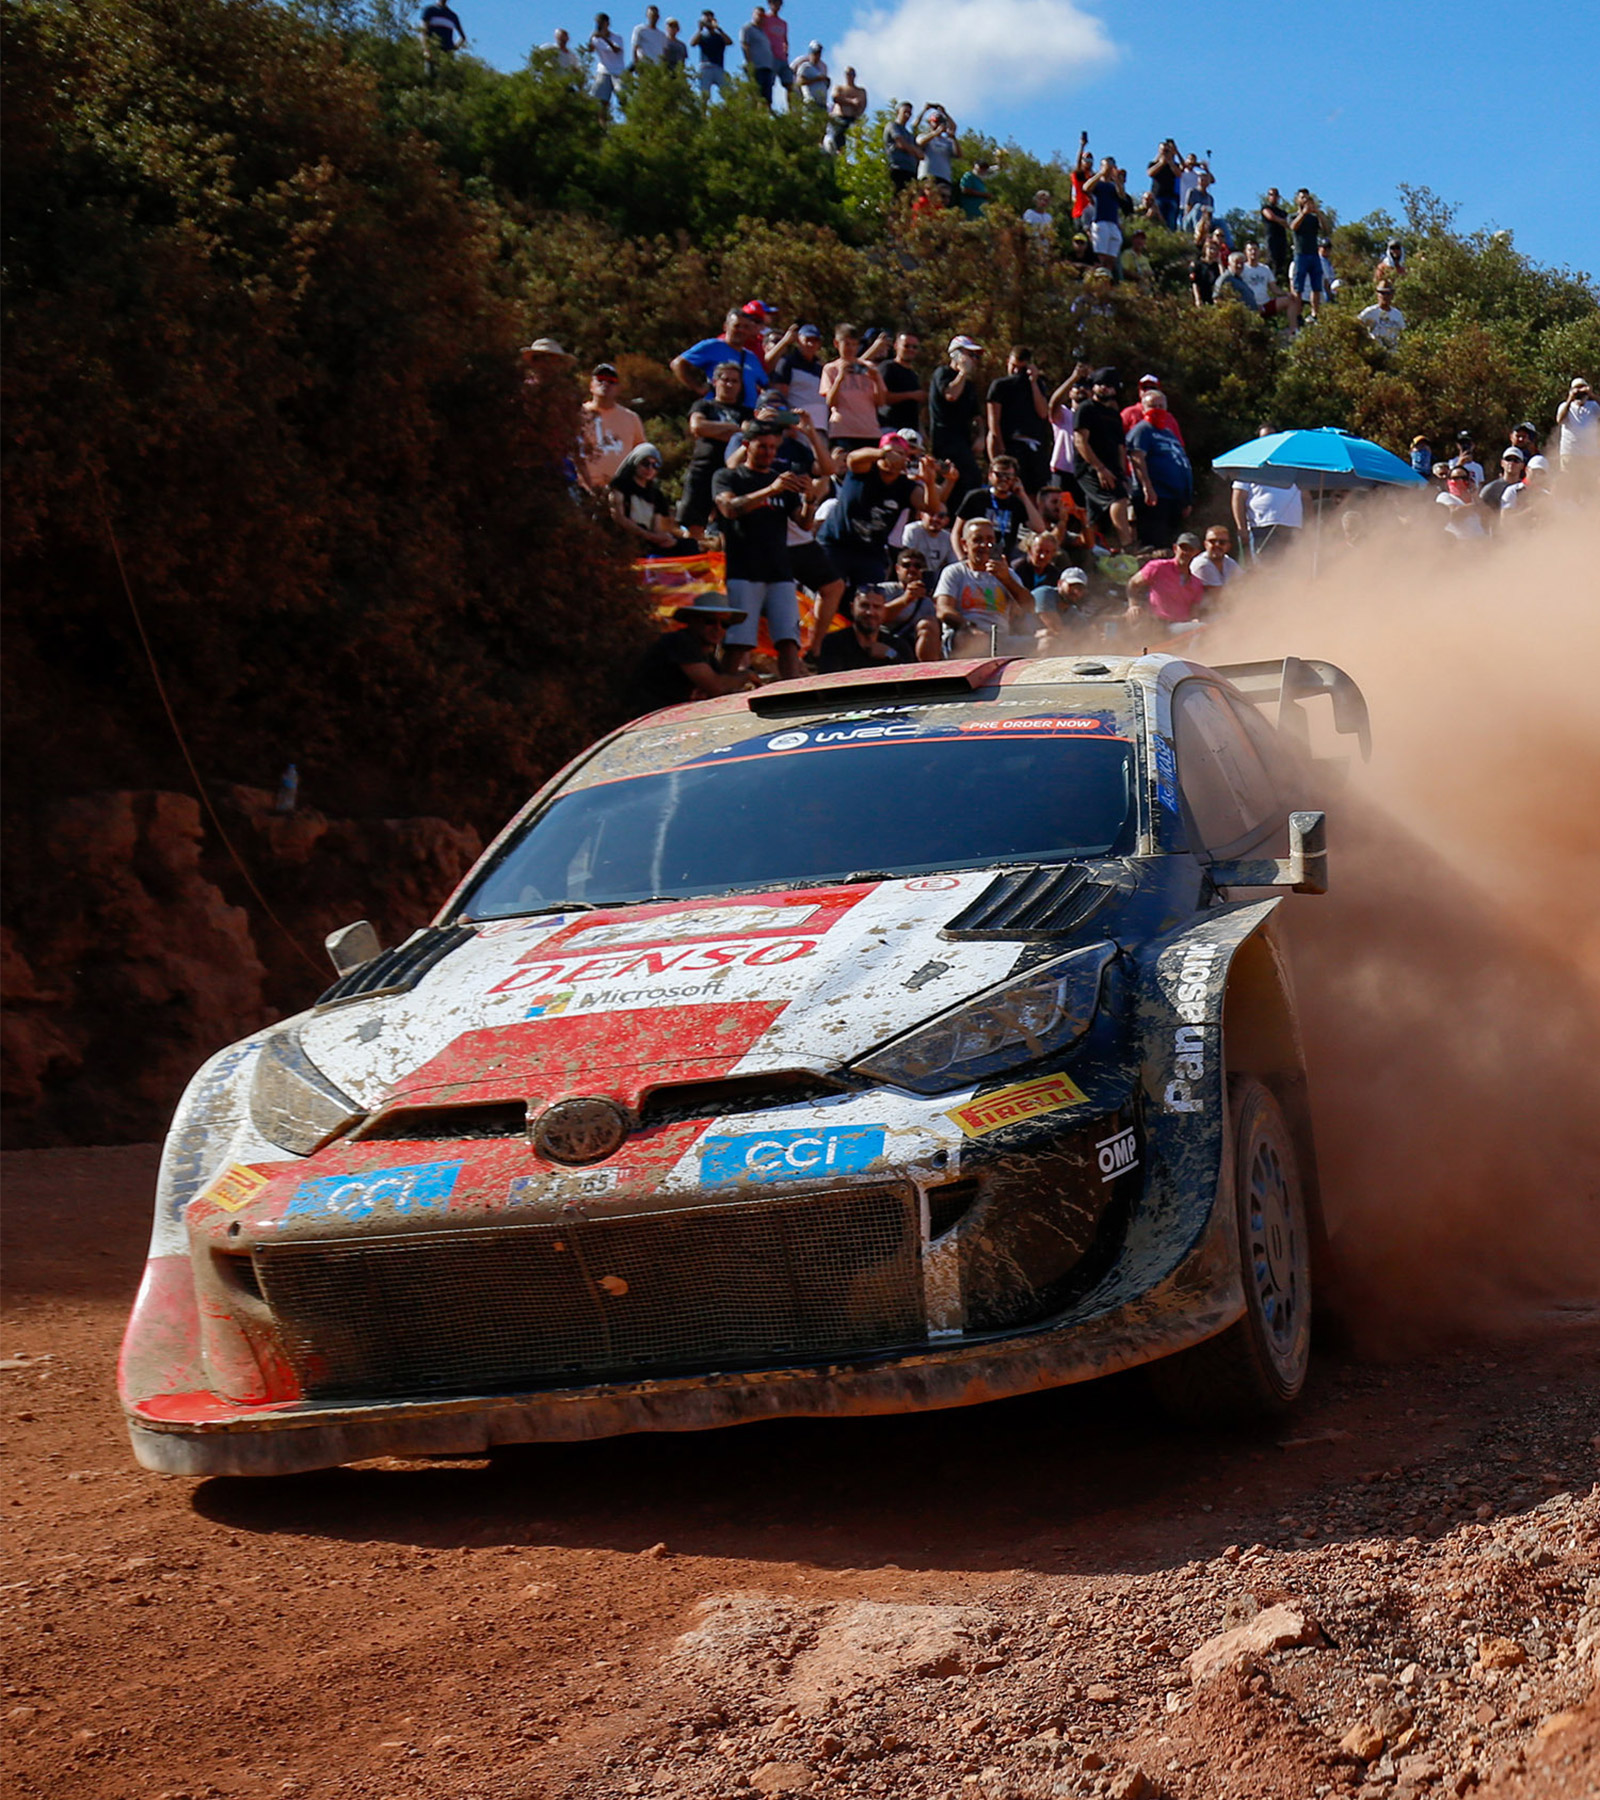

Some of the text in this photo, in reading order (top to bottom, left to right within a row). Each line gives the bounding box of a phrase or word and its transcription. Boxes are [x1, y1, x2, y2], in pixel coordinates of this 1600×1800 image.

[814, 724, 921, 742] WRC
[969, 719, 1092, 730] PRE ORDER NOW
[485, 940, 819, 995] DENSO
[577, 980, 726, 1009] Microsoft
[1163, 943, 1219, 1113] Panasonic
[957, 1079, 1076, 1129] PIRELLI
[1098, 1134, 1137, 1173] OMP
